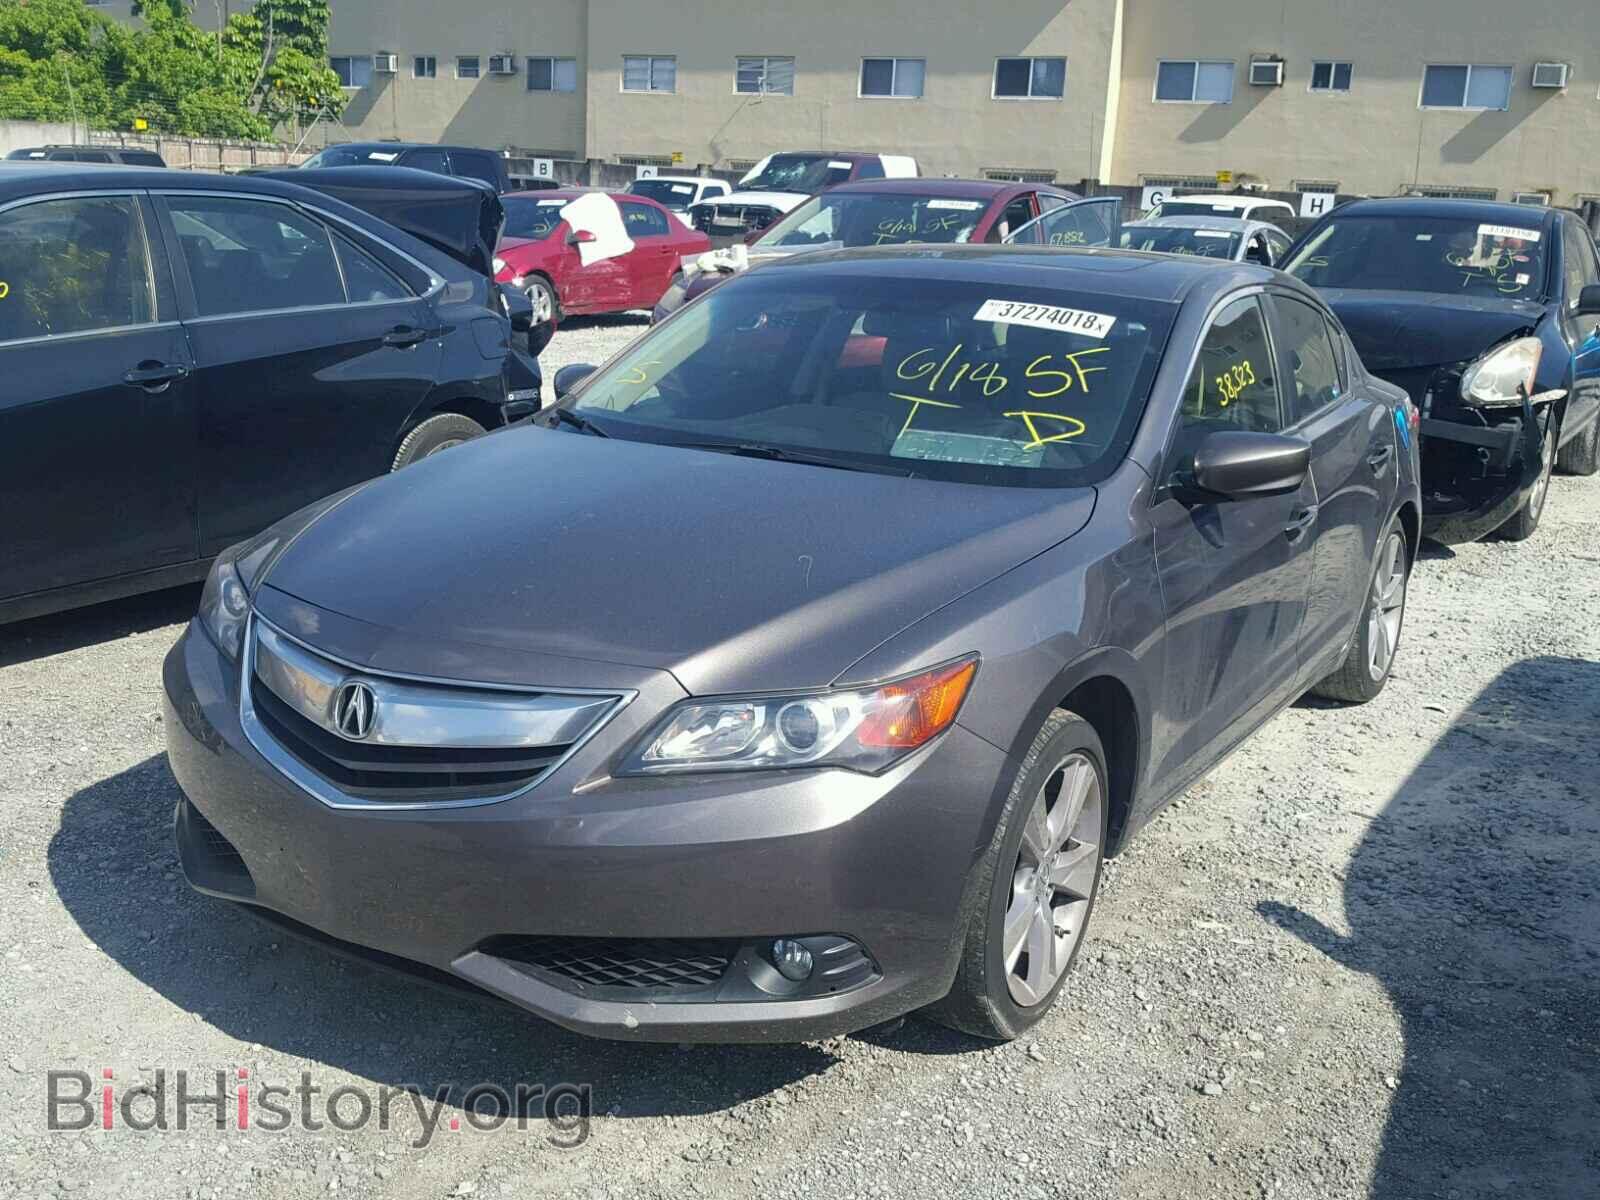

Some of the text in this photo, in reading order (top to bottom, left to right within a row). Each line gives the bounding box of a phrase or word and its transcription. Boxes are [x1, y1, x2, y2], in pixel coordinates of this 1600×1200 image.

[539, 162, 548, 175] B
[1150, 191, 1164, 206] G
[1310, 198, 1324, 213] H
[896, 343, 1111, 397] 6/18 SF
[888, 392, 963, 440] T
[1002, 411, 1086, 450] D
